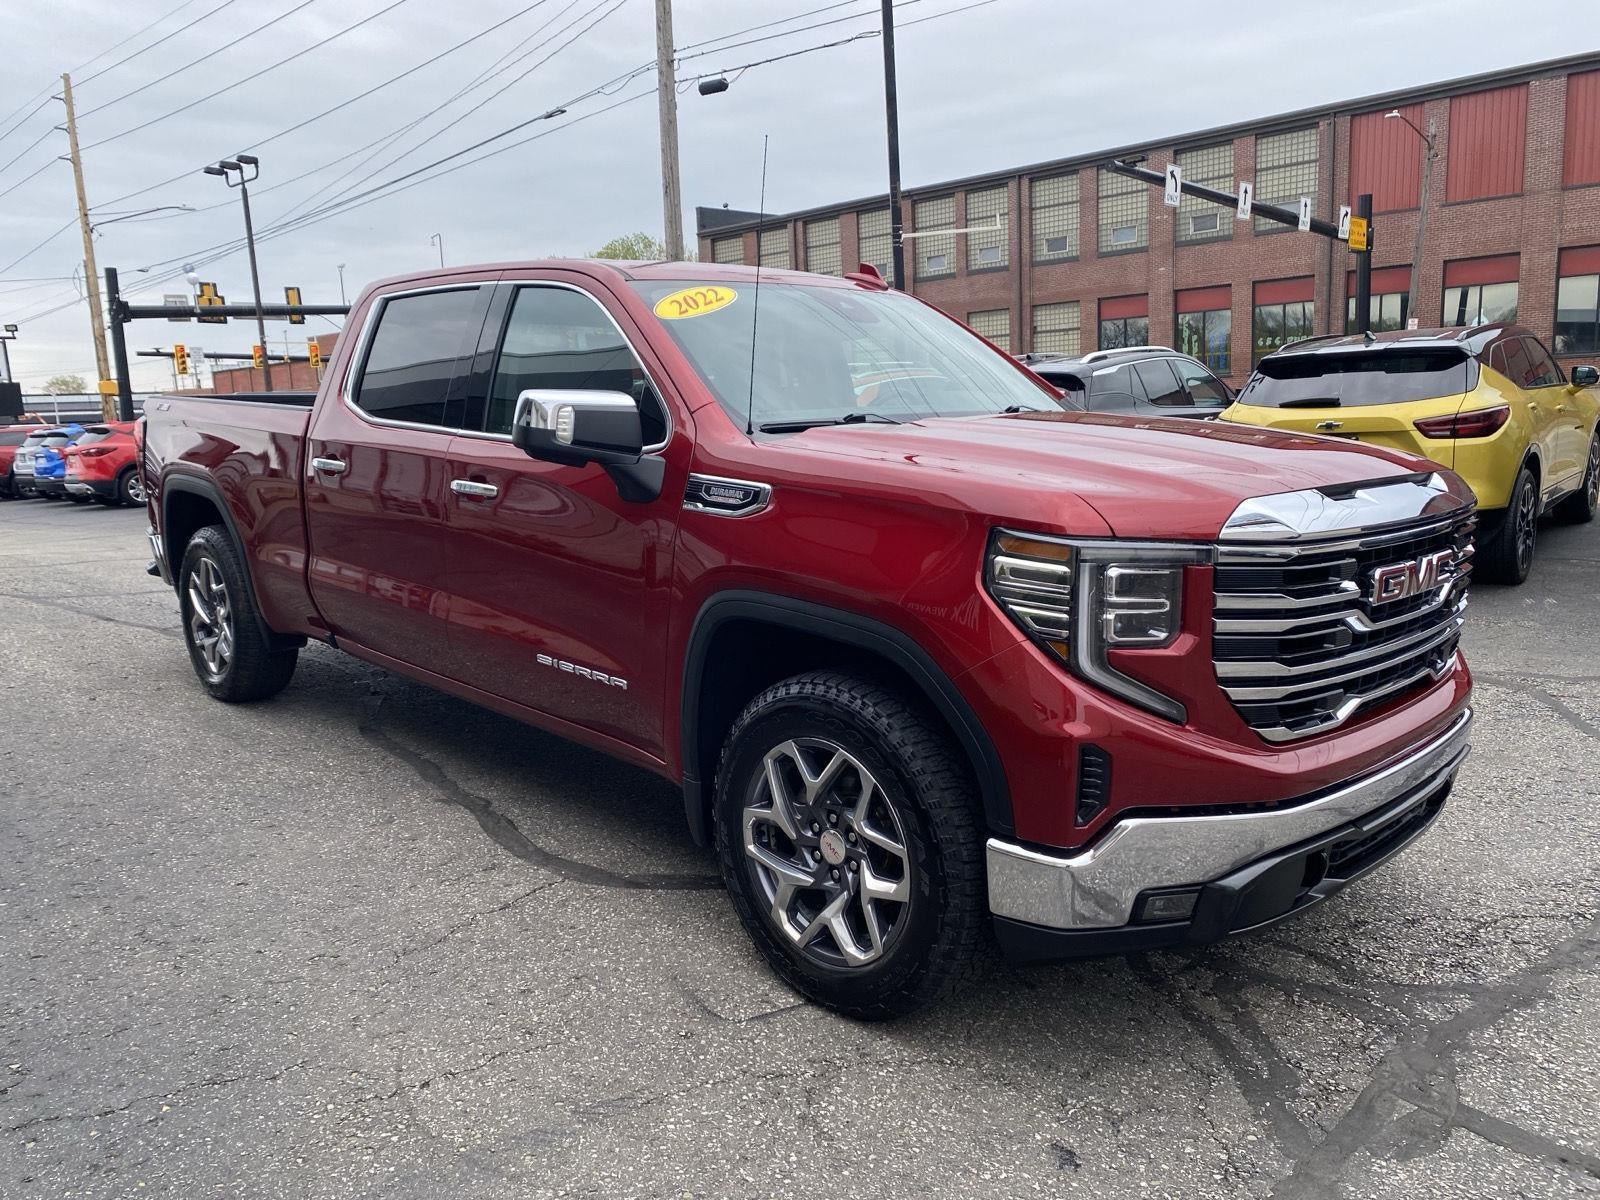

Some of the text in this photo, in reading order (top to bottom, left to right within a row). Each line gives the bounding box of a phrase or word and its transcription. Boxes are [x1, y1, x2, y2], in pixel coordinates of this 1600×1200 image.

[670, 288, 724, 315] 2022
[709, 486, 745, 500] DURAMAX
[1372, 549, 1454, 606] GMC
[536, 653, 628, 690] SIERRA
